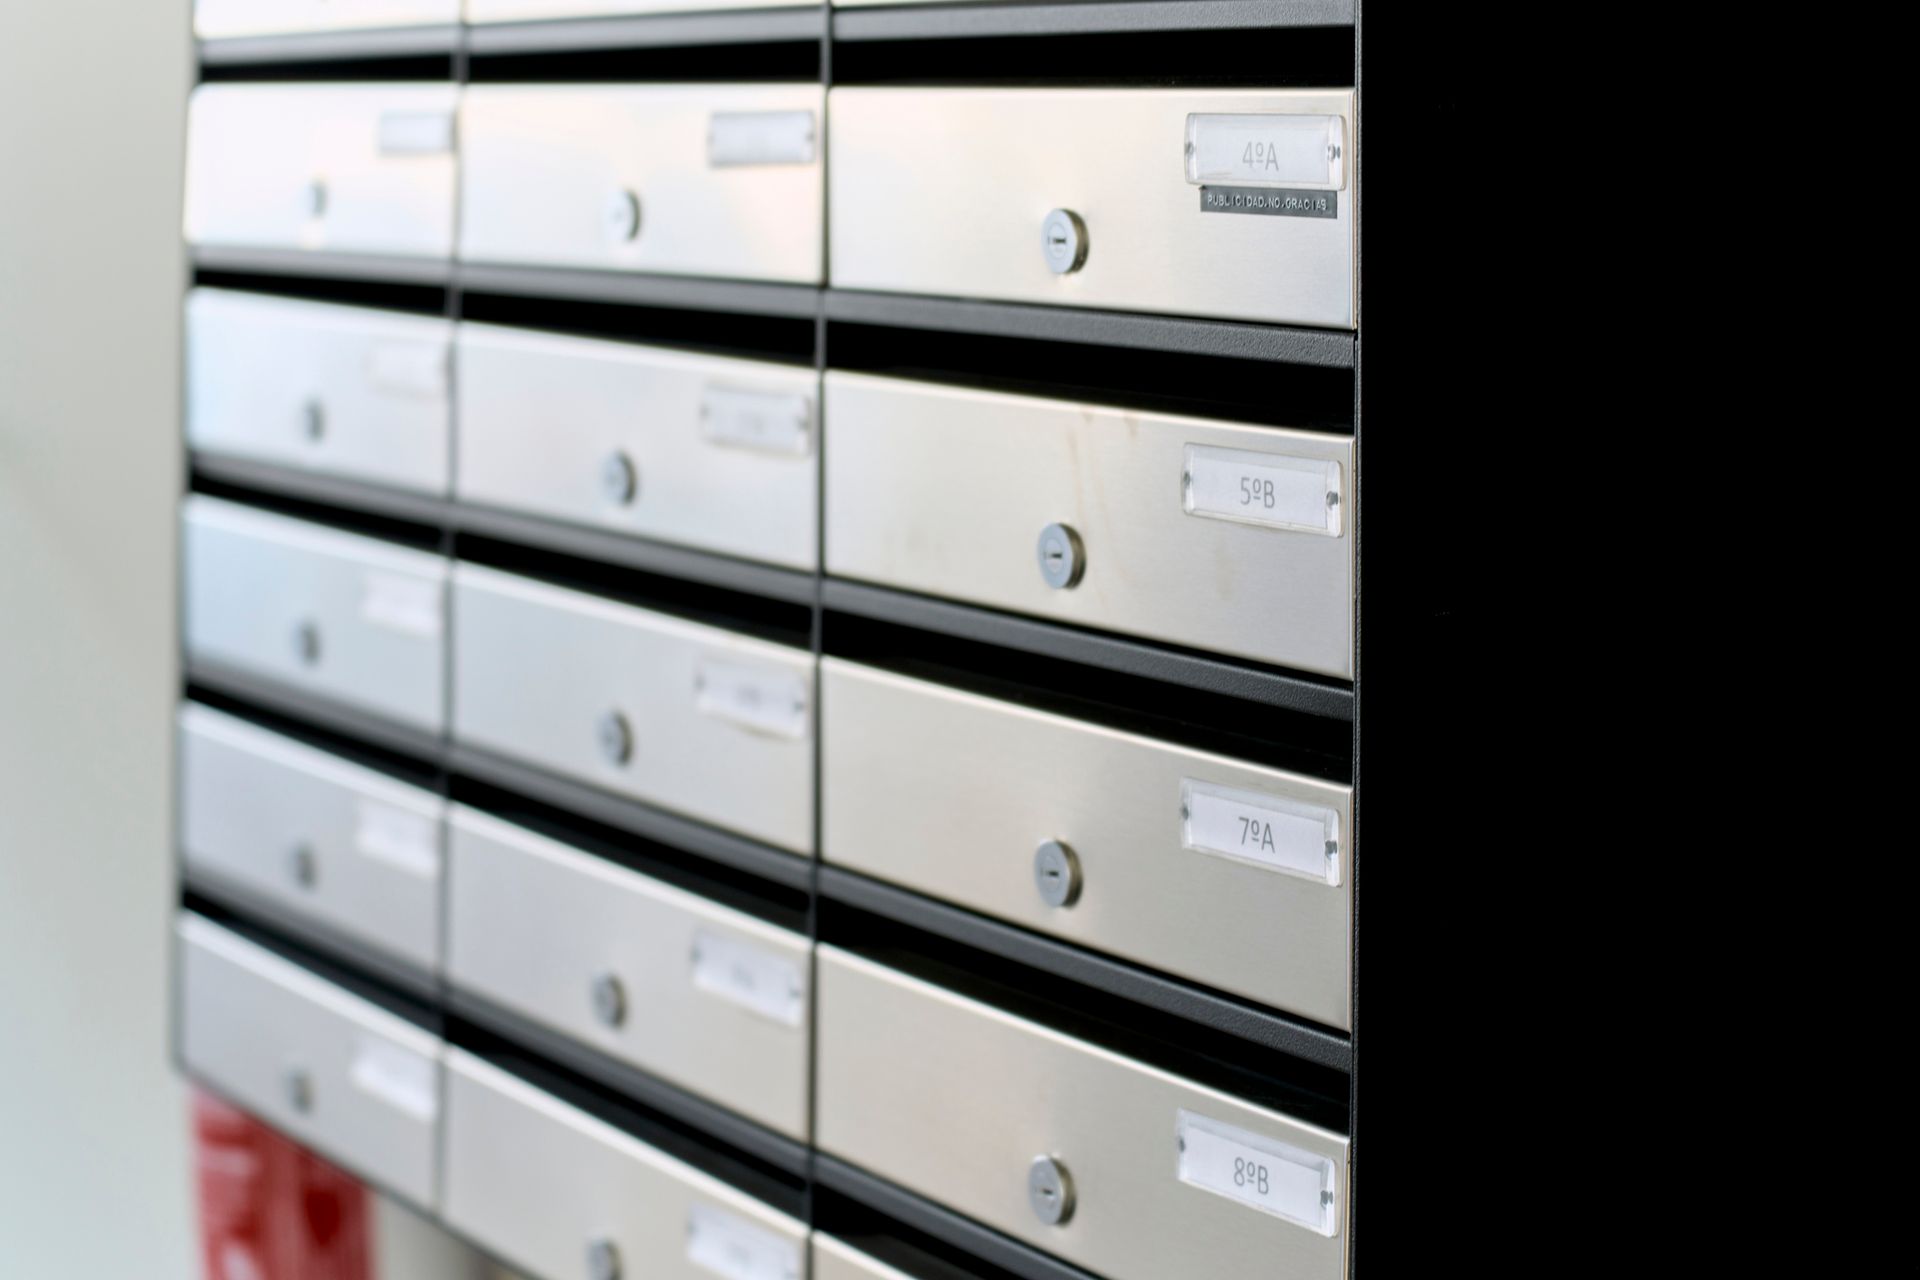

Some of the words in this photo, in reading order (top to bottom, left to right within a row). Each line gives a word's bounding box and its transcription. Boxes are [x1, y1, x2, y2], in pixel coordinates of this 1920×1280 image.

[1240, 476, 1275, 508] 5ºB
[1238, 816, 1275, 853] 7ºA
[1234, 1156, 1269, 1195] 8ºB
